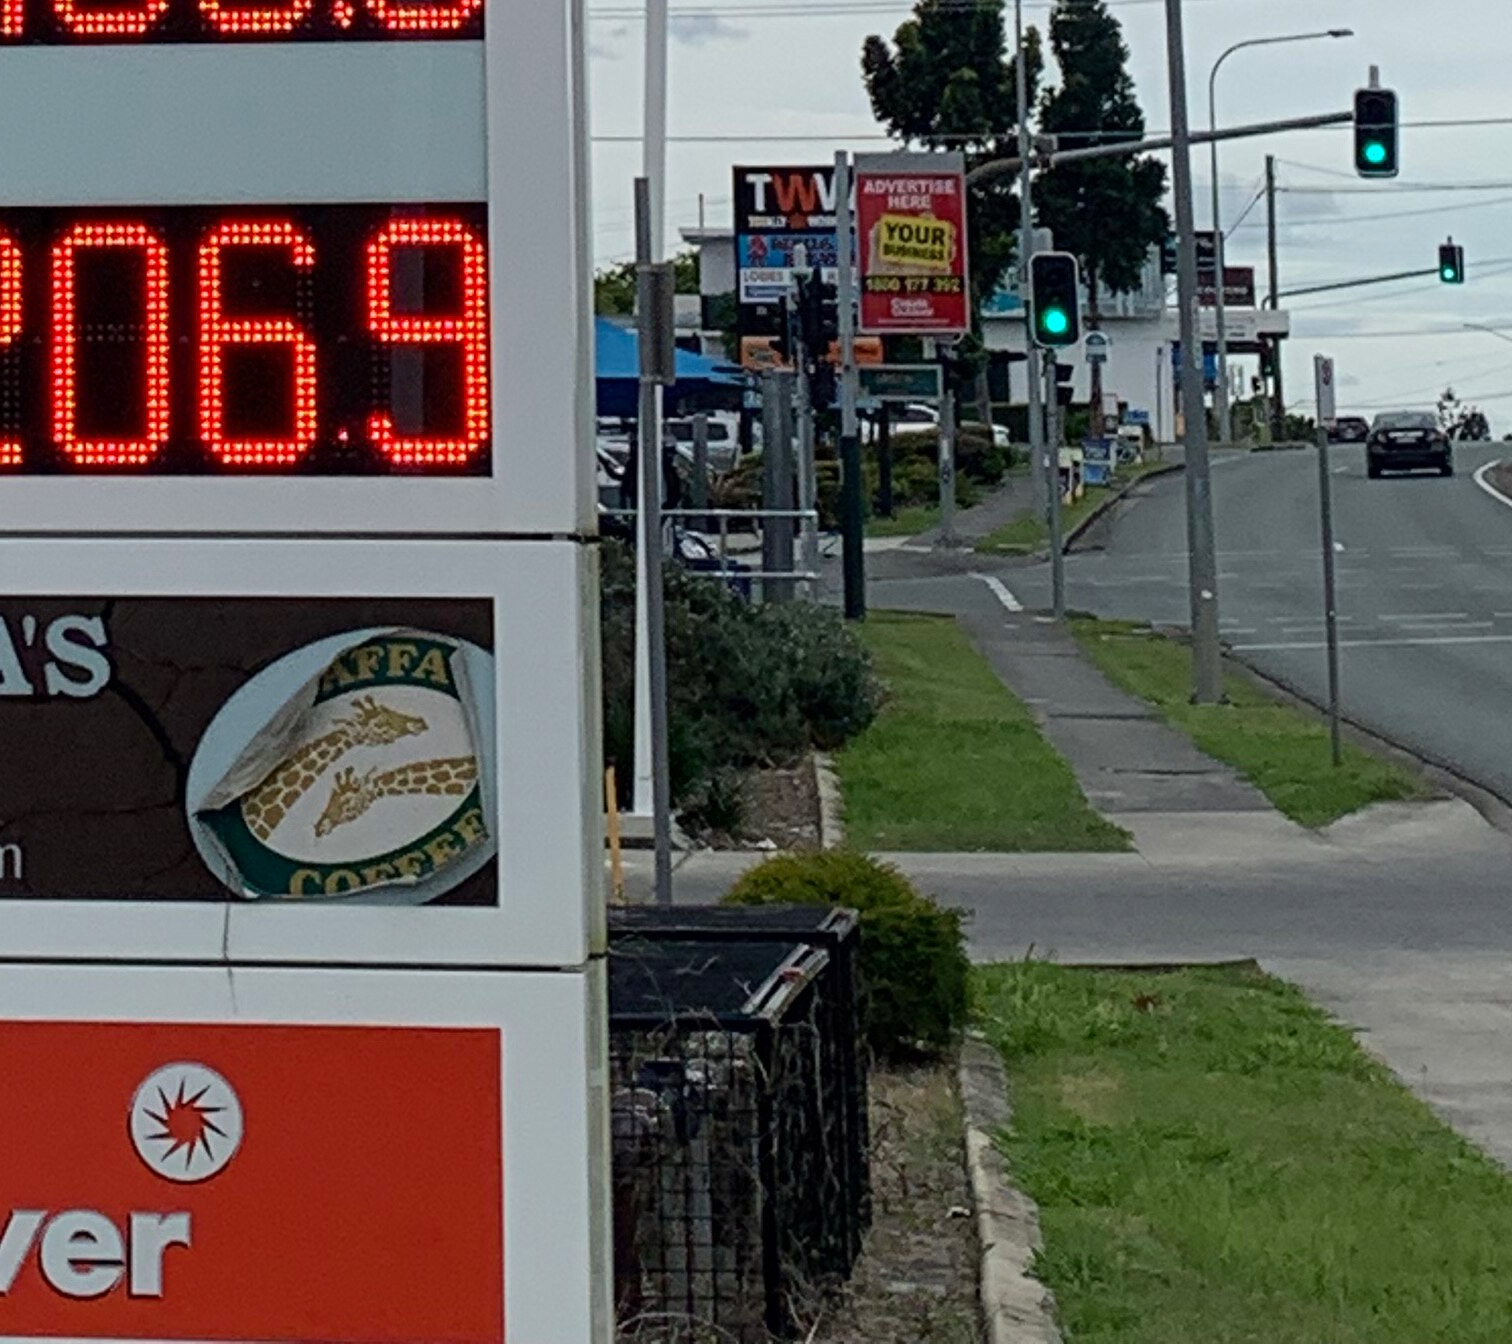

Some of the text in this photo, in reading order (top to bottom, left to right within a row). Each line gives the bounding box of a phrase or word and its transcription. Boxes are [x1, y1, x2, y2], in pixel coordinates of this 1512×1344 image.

[863, 178, 956, 195] ADVERTISE
[887, 194, 931, 209] HERE
[884, 222, 946, 246] YOUR
[883, 243, 945, 262] BUSINESS
[866, 277, 901, 292] 1800
